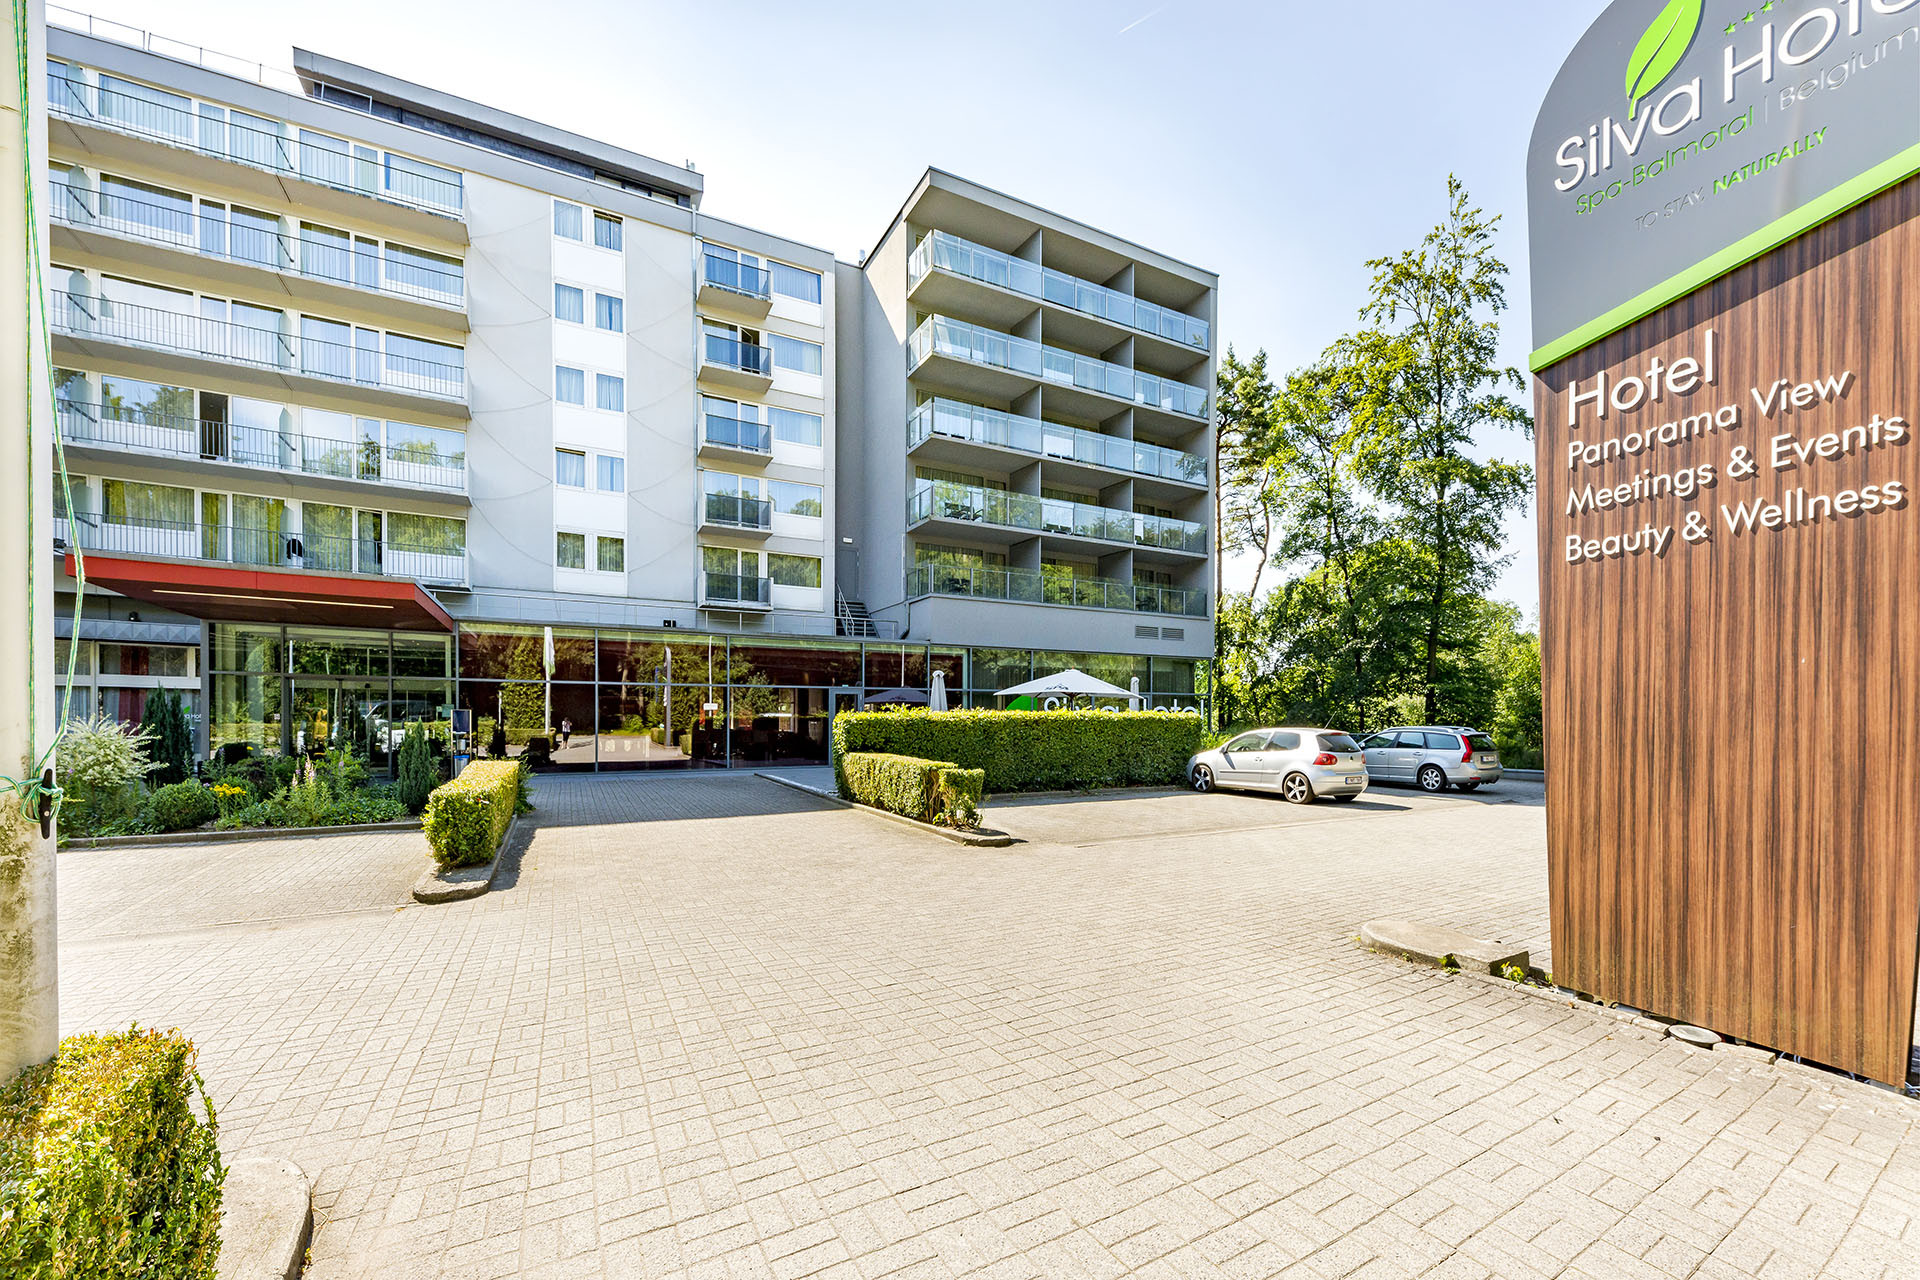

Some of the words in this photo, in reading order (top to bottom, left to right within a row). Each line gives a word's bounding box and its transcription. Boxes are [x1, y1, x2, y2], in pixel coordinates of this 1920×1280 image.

[1554, 76, 1702, 192] Silva
[1723, 0, 1918, 104] Hot
[1575, 105, 1754, 216] Spa-Balmoral
[1779, 25, 1919, 111] Belgium
[1634, 209, 1659, 233] TO
[1713, 126, 1828, 195] NATURALLY
[1567, 327, 1719, 428] Hotel
[1568, 404, 1739, 470] Panorama
[1750, 370, 1854, 418] View
[1565, 462, 1714, 516] Meetings
[1726, 445, 1757, 479] &
[1771, 413, 1907, 470] Events
[1565, 524, 1672, 563] Beauty
[1681, 511, 1710, 543] &
[1721, 480, 1904, 535] Wellness
